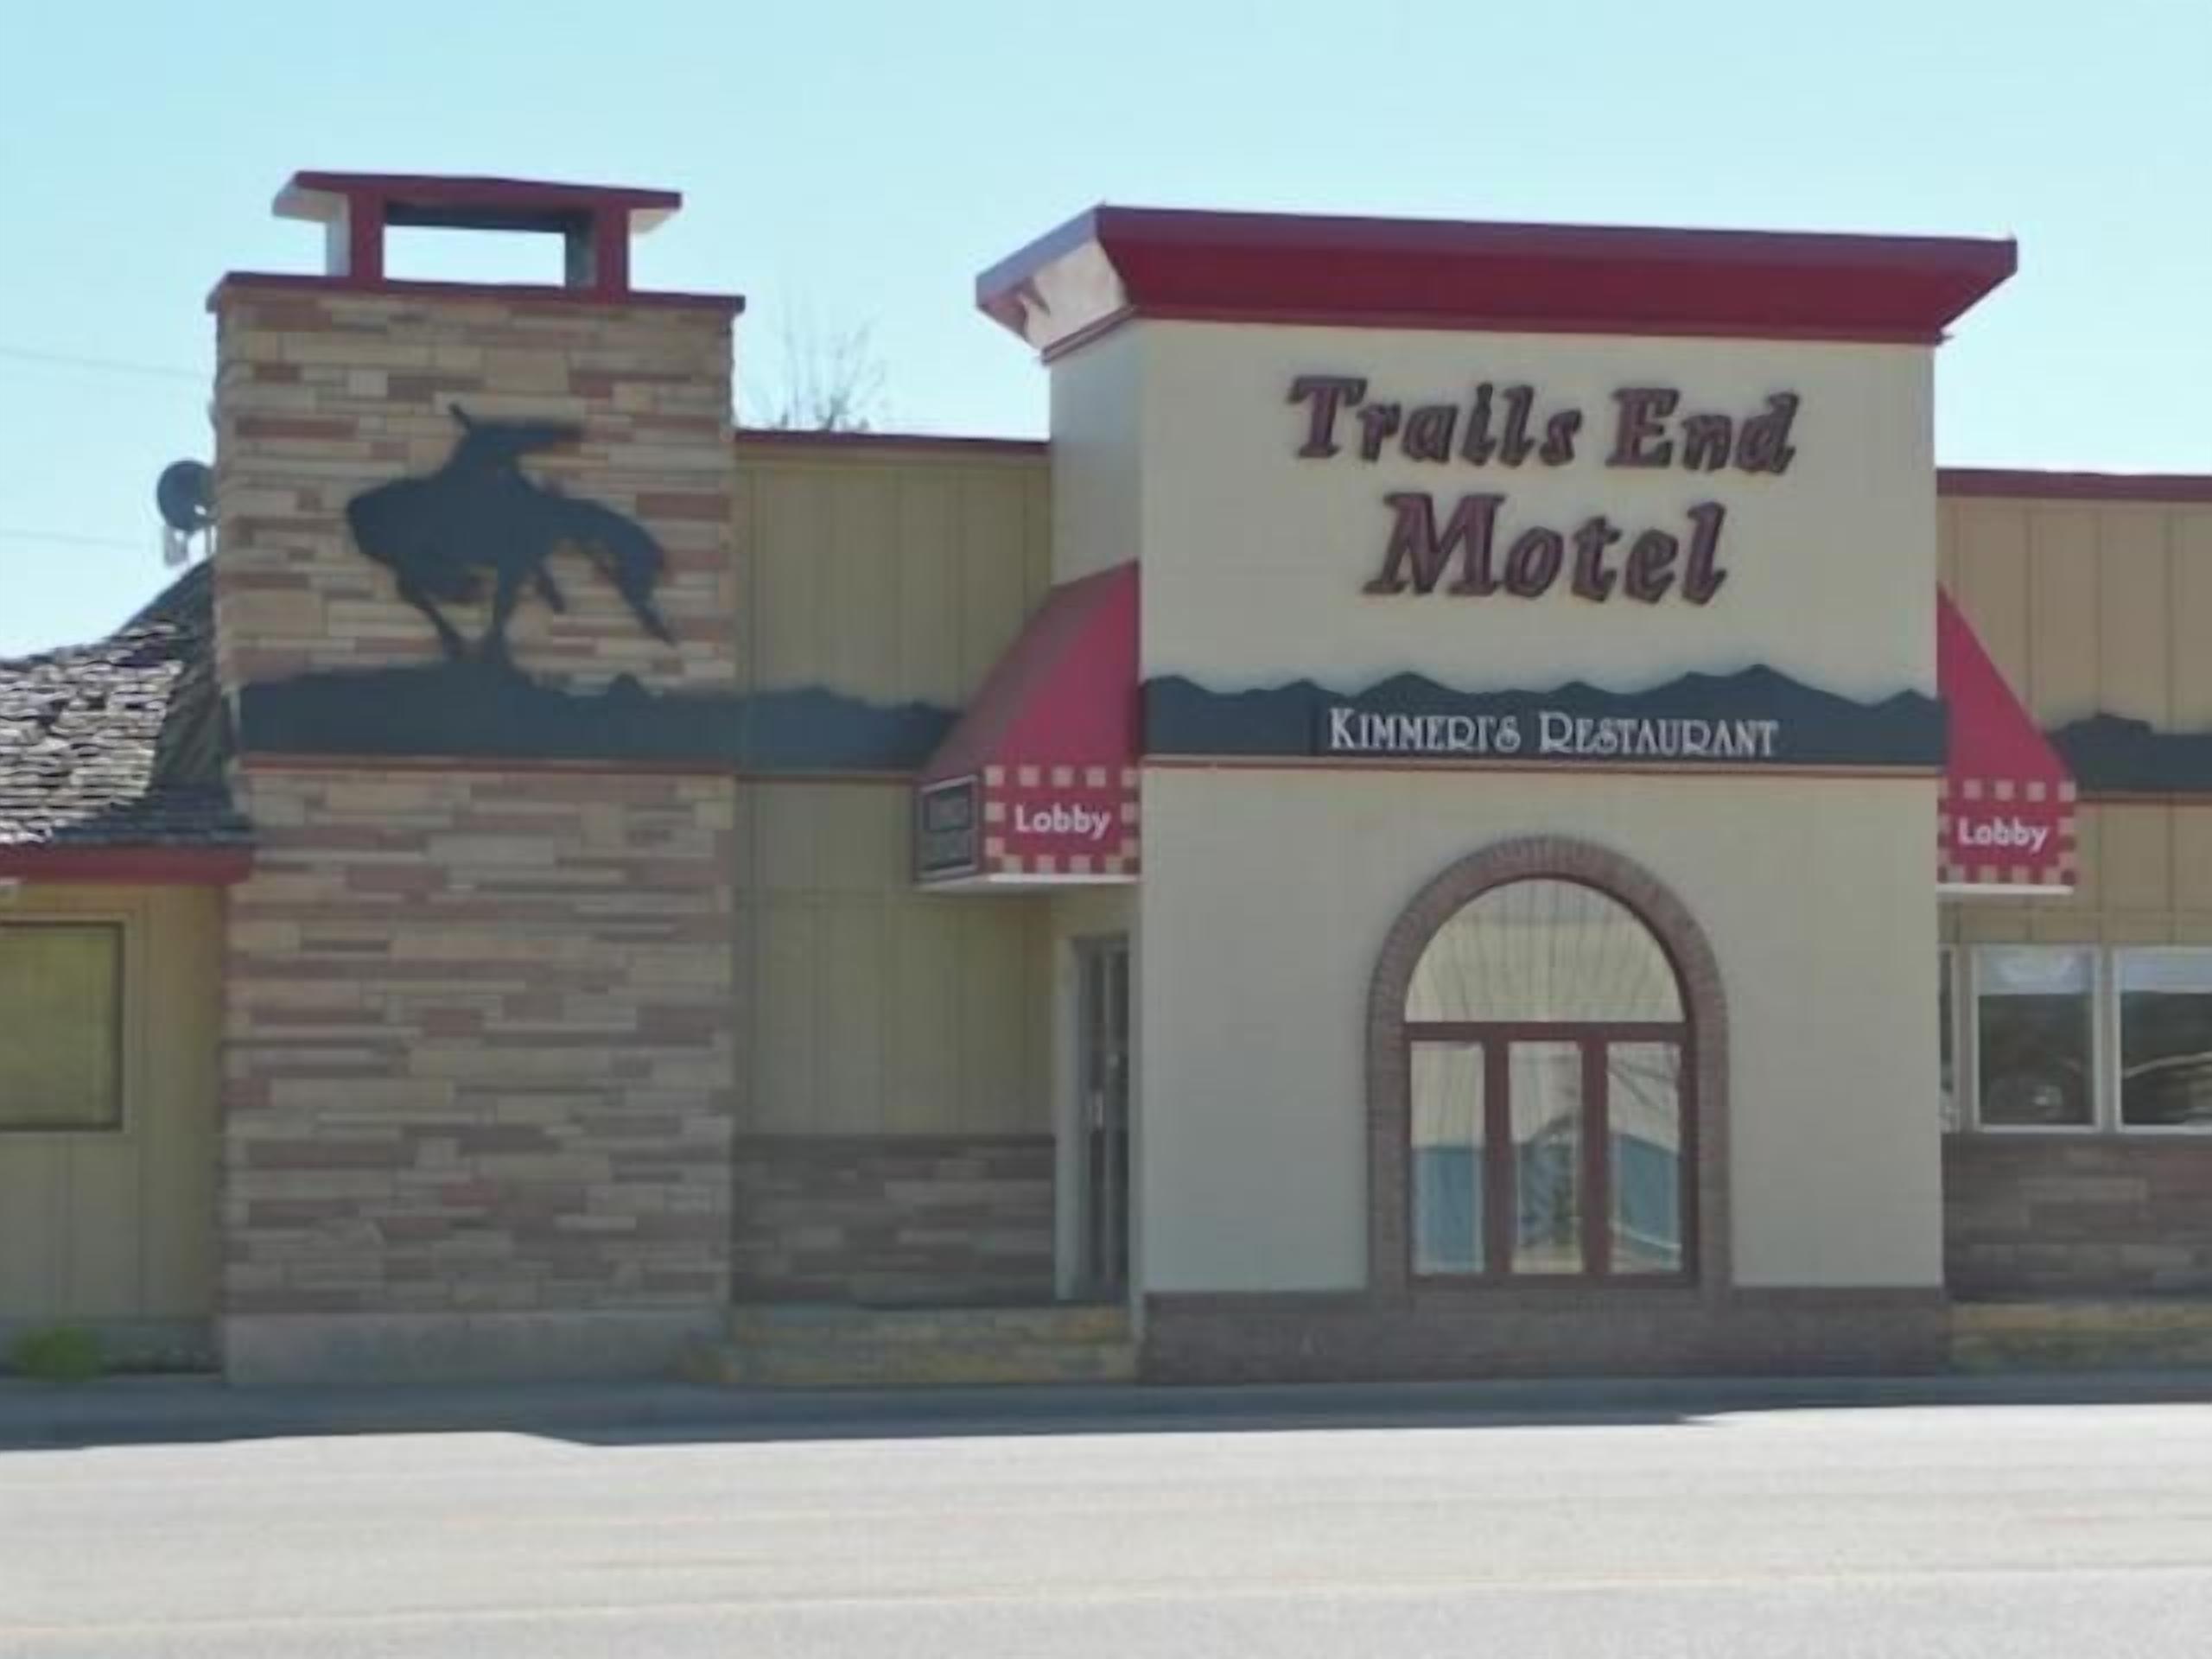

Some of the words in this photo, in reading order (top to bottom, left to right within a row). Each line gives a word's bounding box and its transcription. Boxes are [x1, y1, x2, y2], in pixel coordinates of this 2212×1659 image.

[1288, 375, 1582, 467] Trails
[1605, 386, 1800, 474] End
[1362, 492, 1727, 605] Motel
[1539, 711, 1779, 757] RESTAURANT
[1014, 802, 1111, 841] Lobby
[1958, 817, 2048, 853] Lobby
